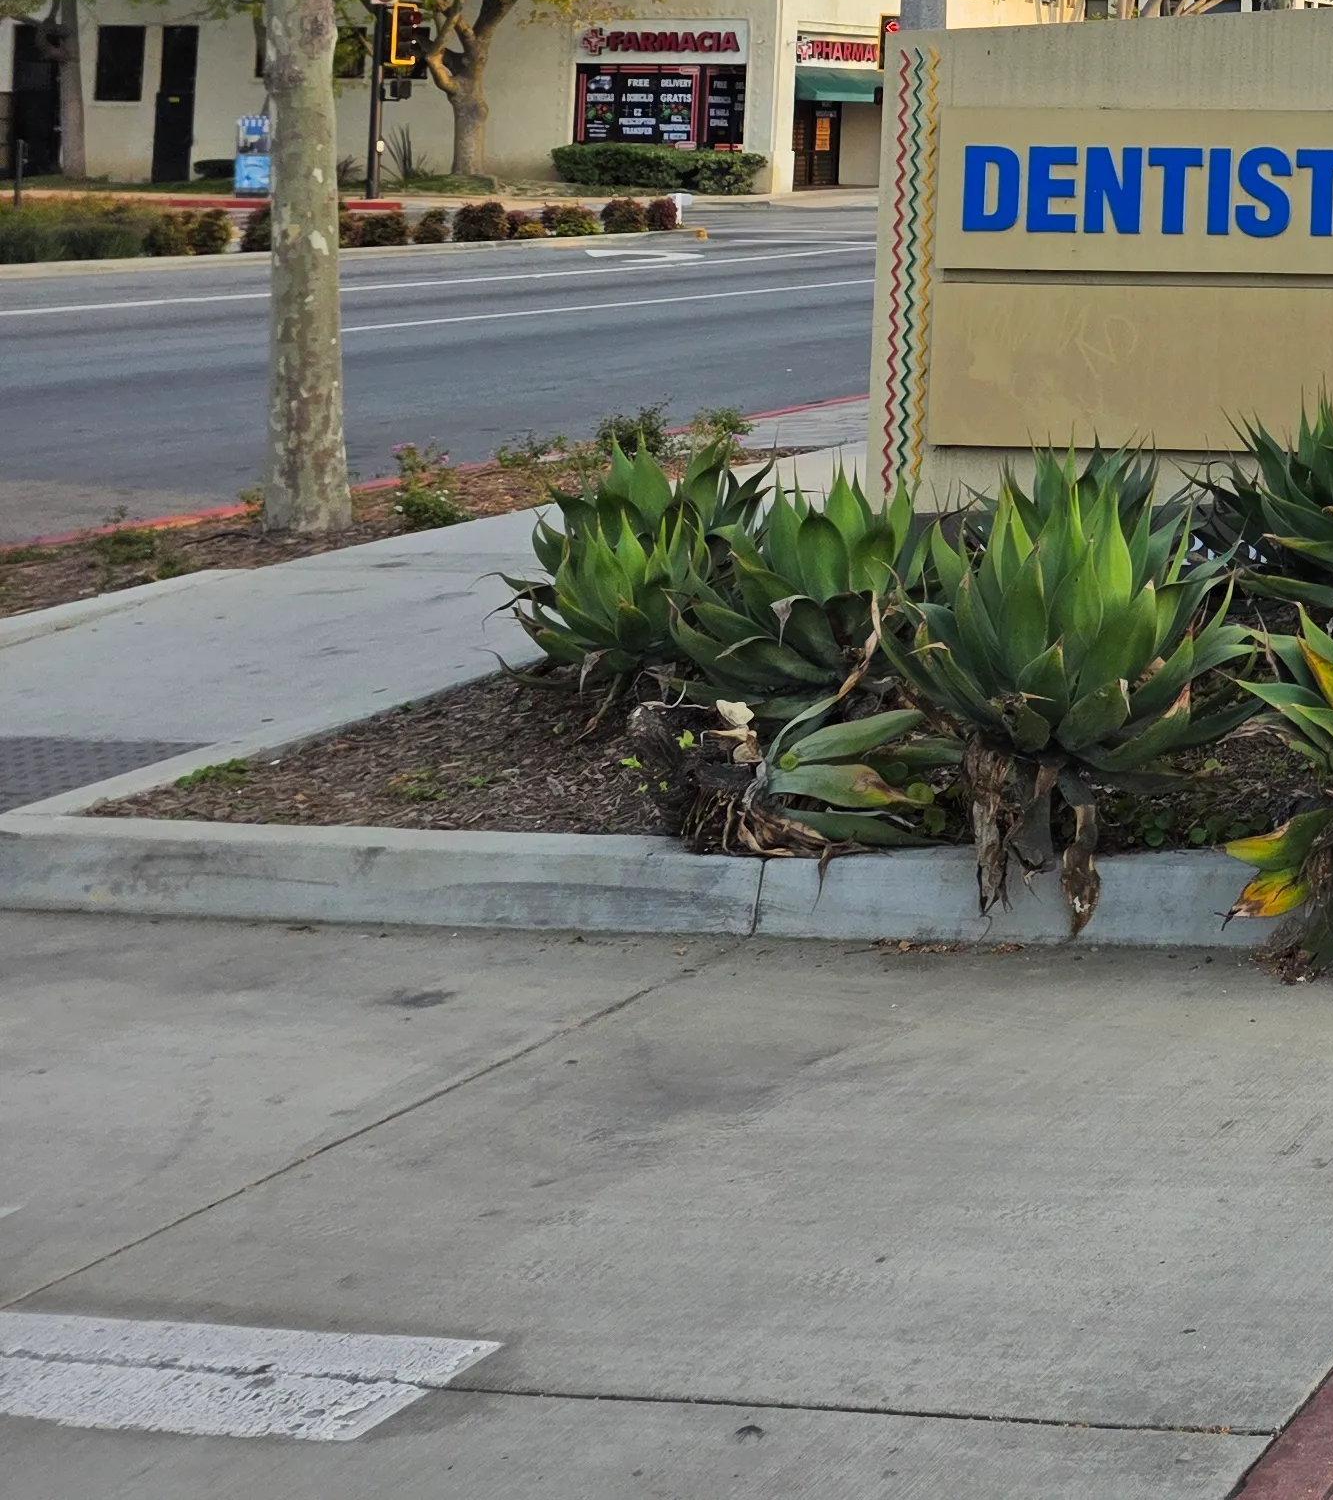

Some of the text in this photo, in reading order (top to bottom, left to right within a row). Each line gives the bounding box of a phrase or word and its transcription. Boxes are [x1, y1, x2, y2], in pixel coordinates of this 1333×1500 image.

[609, 31, 740, 52] FARMACIA
[628, 79, 650, 87] FREE
[660, 94, 692, 102] GRATIS
